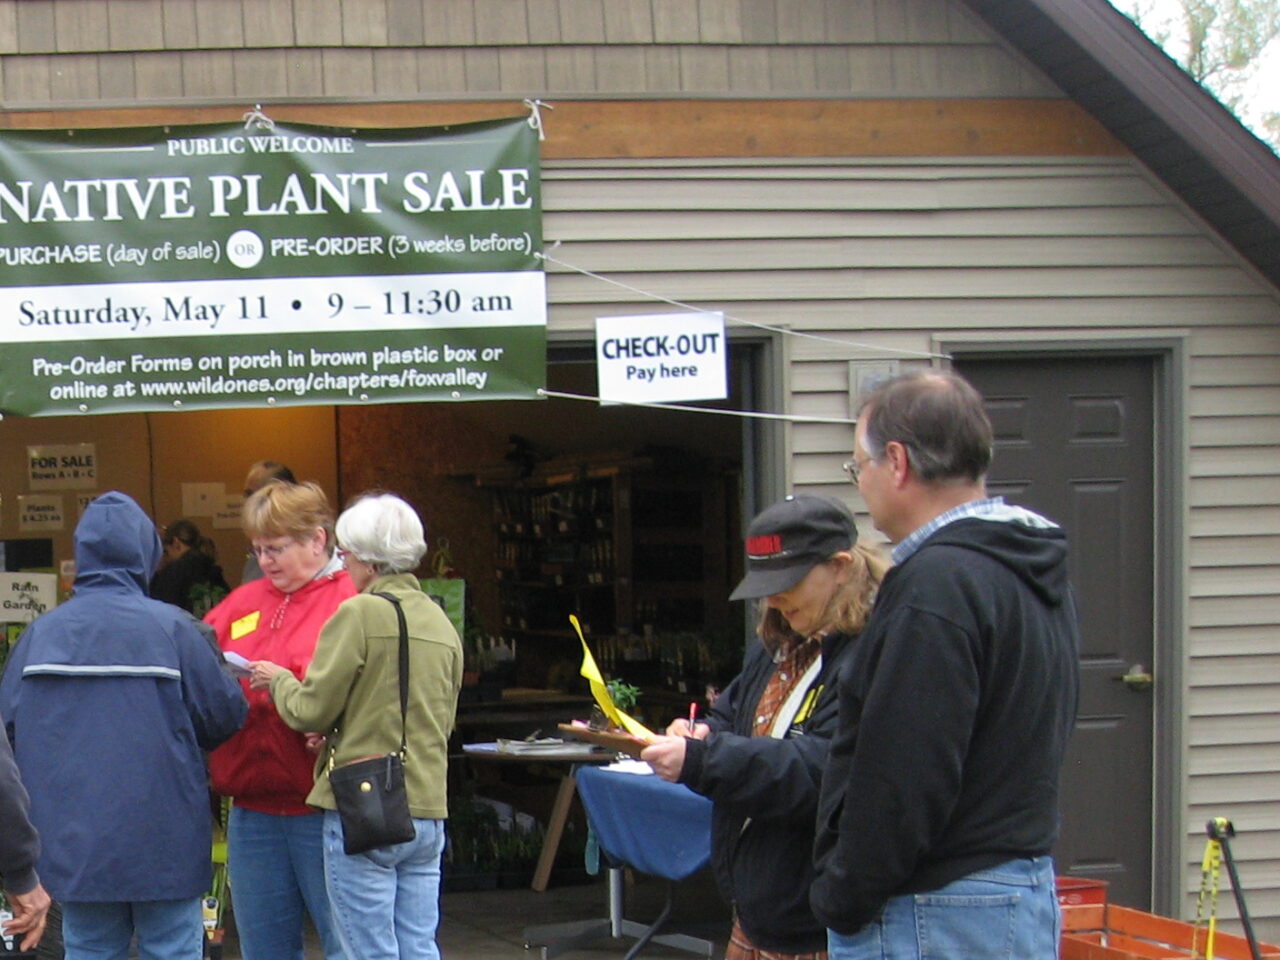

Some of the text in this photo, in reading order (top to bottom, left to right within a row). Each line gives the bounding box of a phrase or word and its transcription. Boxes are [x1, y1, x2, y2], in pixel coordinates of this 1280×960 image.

[167, 136, 355, 157] PUBLIC WELCOME
[208, 168, 388, 217] PLANT
[402, 167, 534, 213] SALE
[106, 243, 147, 267] (day
[152, 241, 172, 260] of
[175, 239, 221, 264] sale)
[234, 242, 256, 257] OR
[271, 236, 385, 257] PRE-ORDER
[388, 234, 410, 259] (3
[413, 234, 466, 254] weeks
[470, 231, 532, 256] before)
[18, 297, 152, 332] Saturday,
[162, 295, 226, 329] May
[238, 295, 269, 320] 11
[328, 292, 345, 318] 9
[383, 288, 462, 316] 11:30
[472, 292, 513, 313] am
[602, 333, 720, 360] CHECK-OUT
[32, 344, 504, 377] Pre-Order Forms on porch in brown plastic box or
[50, 367, 488, 400] online at www.wildones.org/chapters/foxvalley
[626, 363, 699, 383] Pay here
[31, 455, 93, 469] FOR SALE
[58, 470, 66, 479] A
[87, 470, 94, 478] C
[11, 580, 39, 592] Rain
[3, 599, 47, 611] Garden
